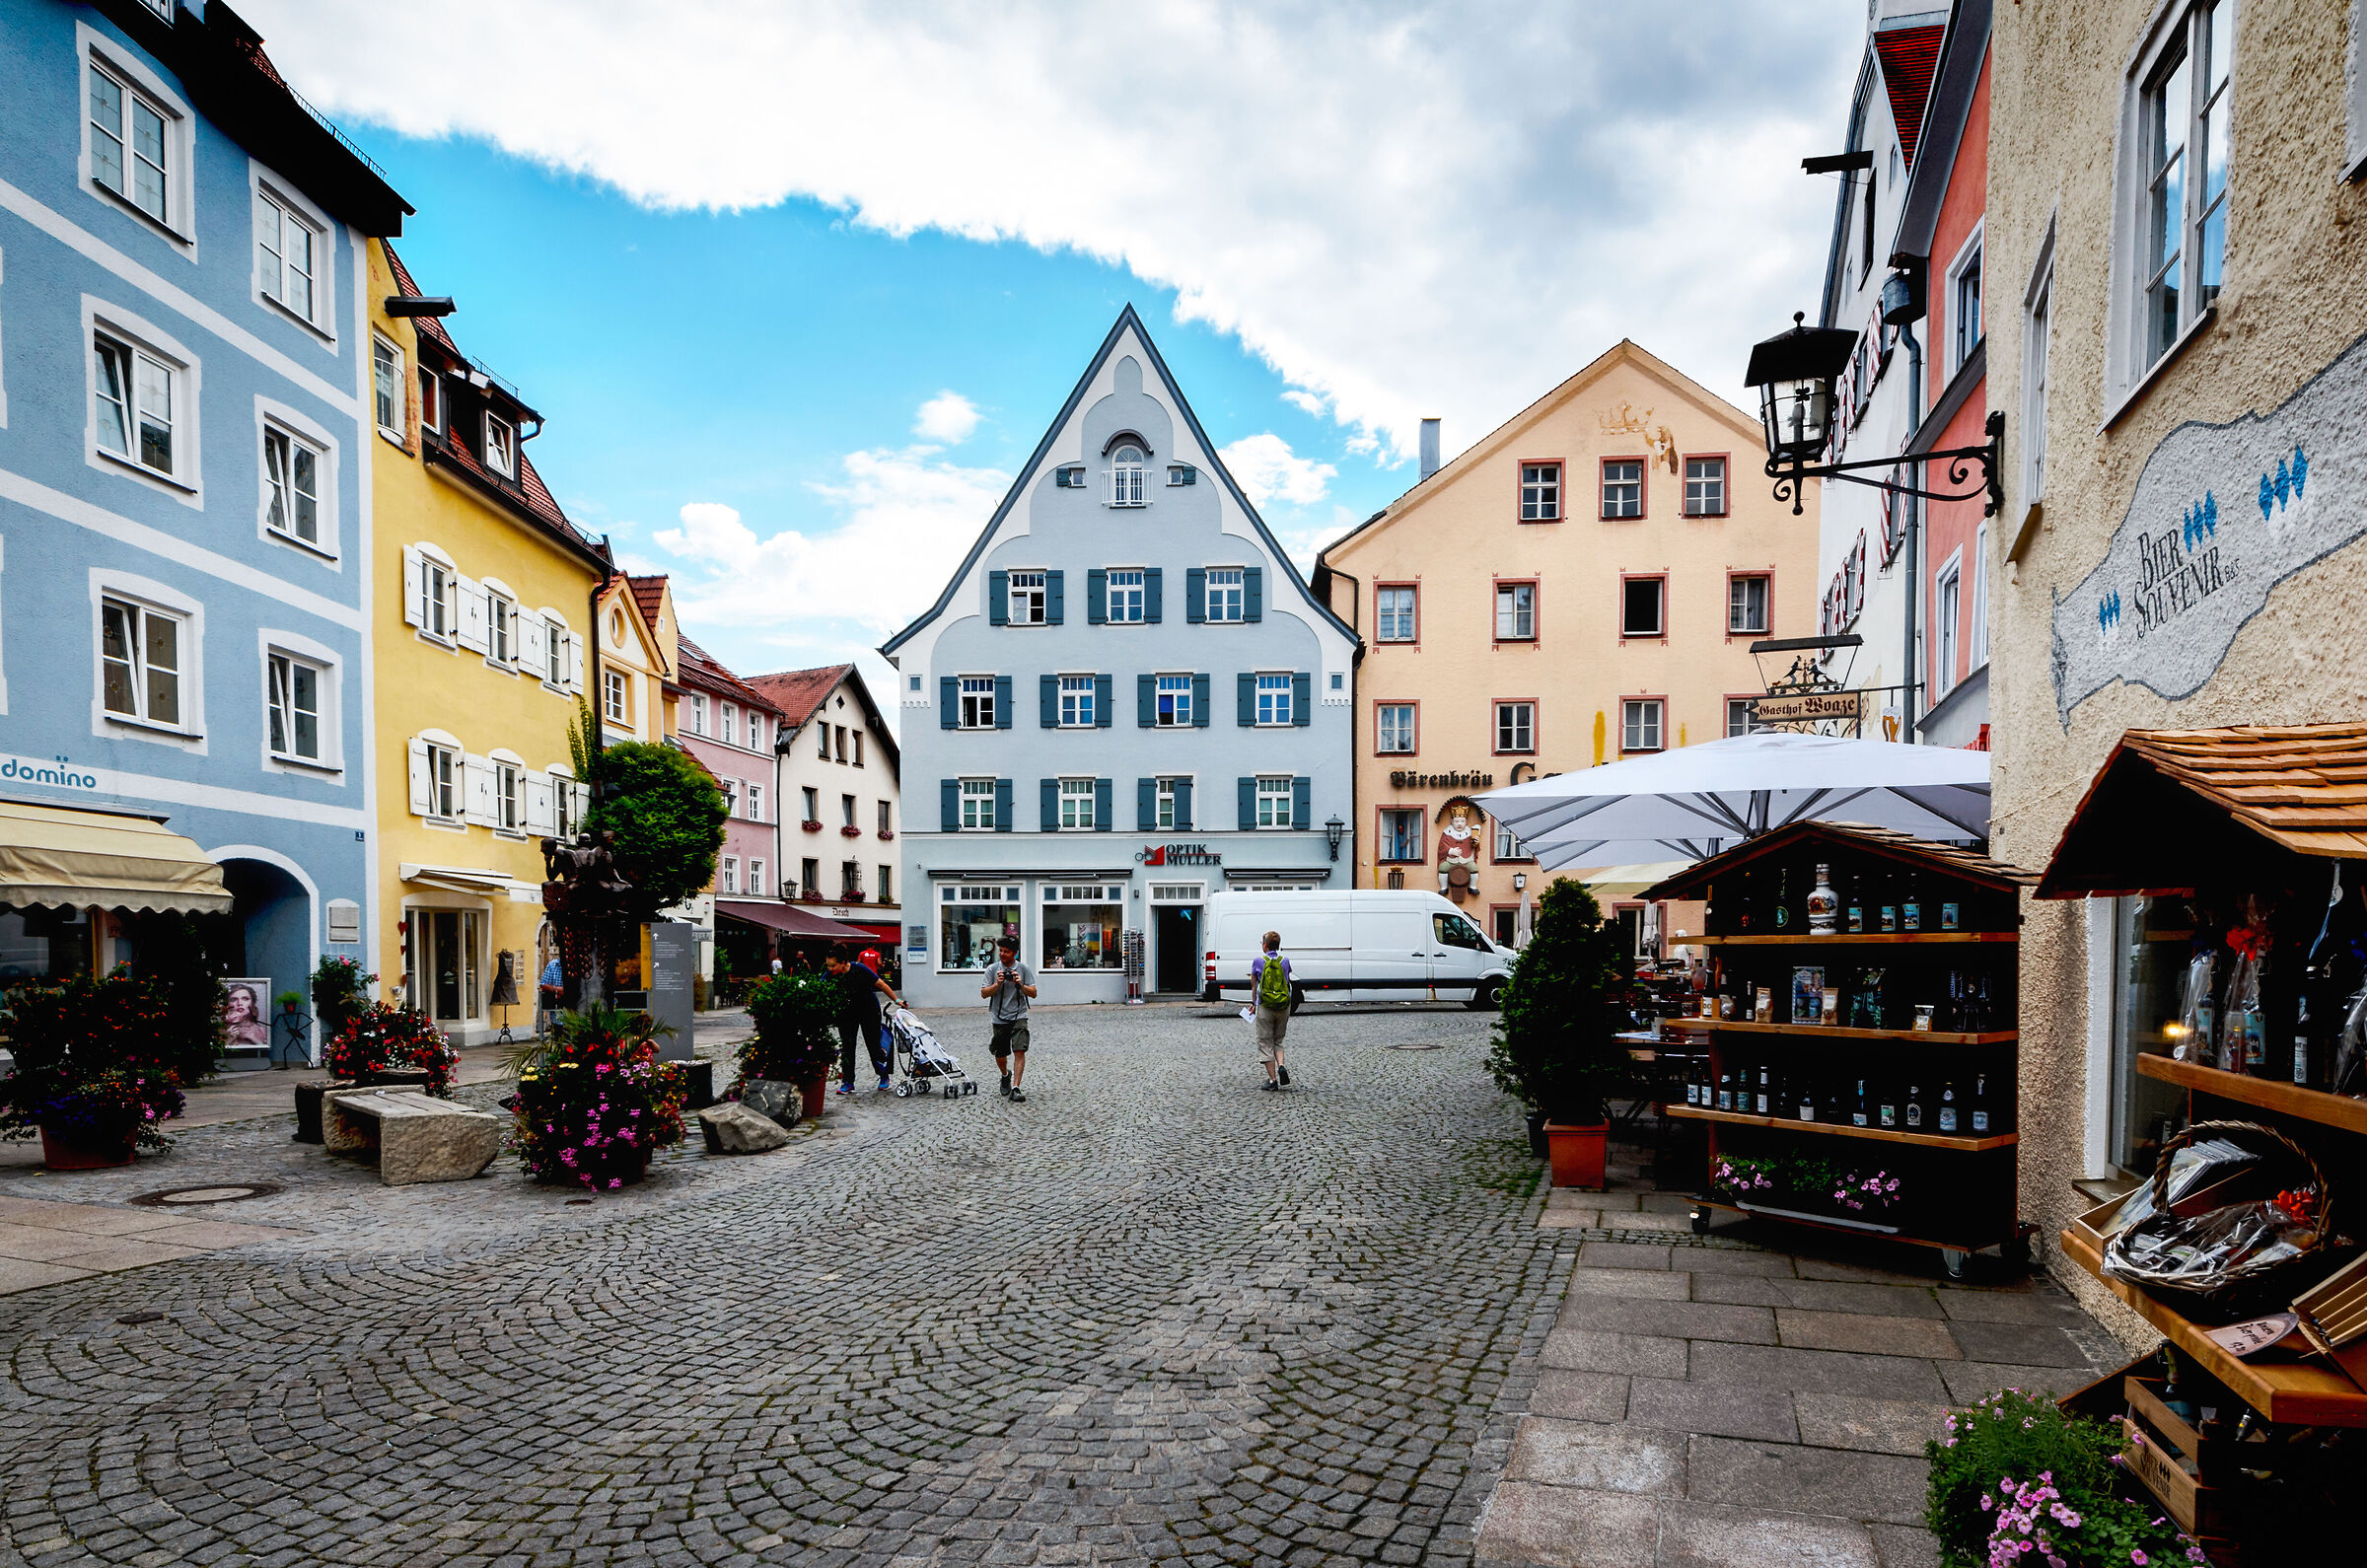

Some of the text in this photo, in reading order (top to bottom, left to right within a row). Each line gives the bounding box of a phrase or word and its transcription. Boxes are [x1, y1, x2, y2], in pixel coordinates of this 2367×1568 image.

[2136, 529, 2184, 594] BIER
[2134, 546, 2224, 641] SOUVENIR
[1758, 696, 1856, 717] Gasthof Woaze
[1390, 768, 1493, 789] Bärenbräu
[1166, 844, 1207, 854] OPTIK
[1166, 853, 1222, 866] MÜLLER
